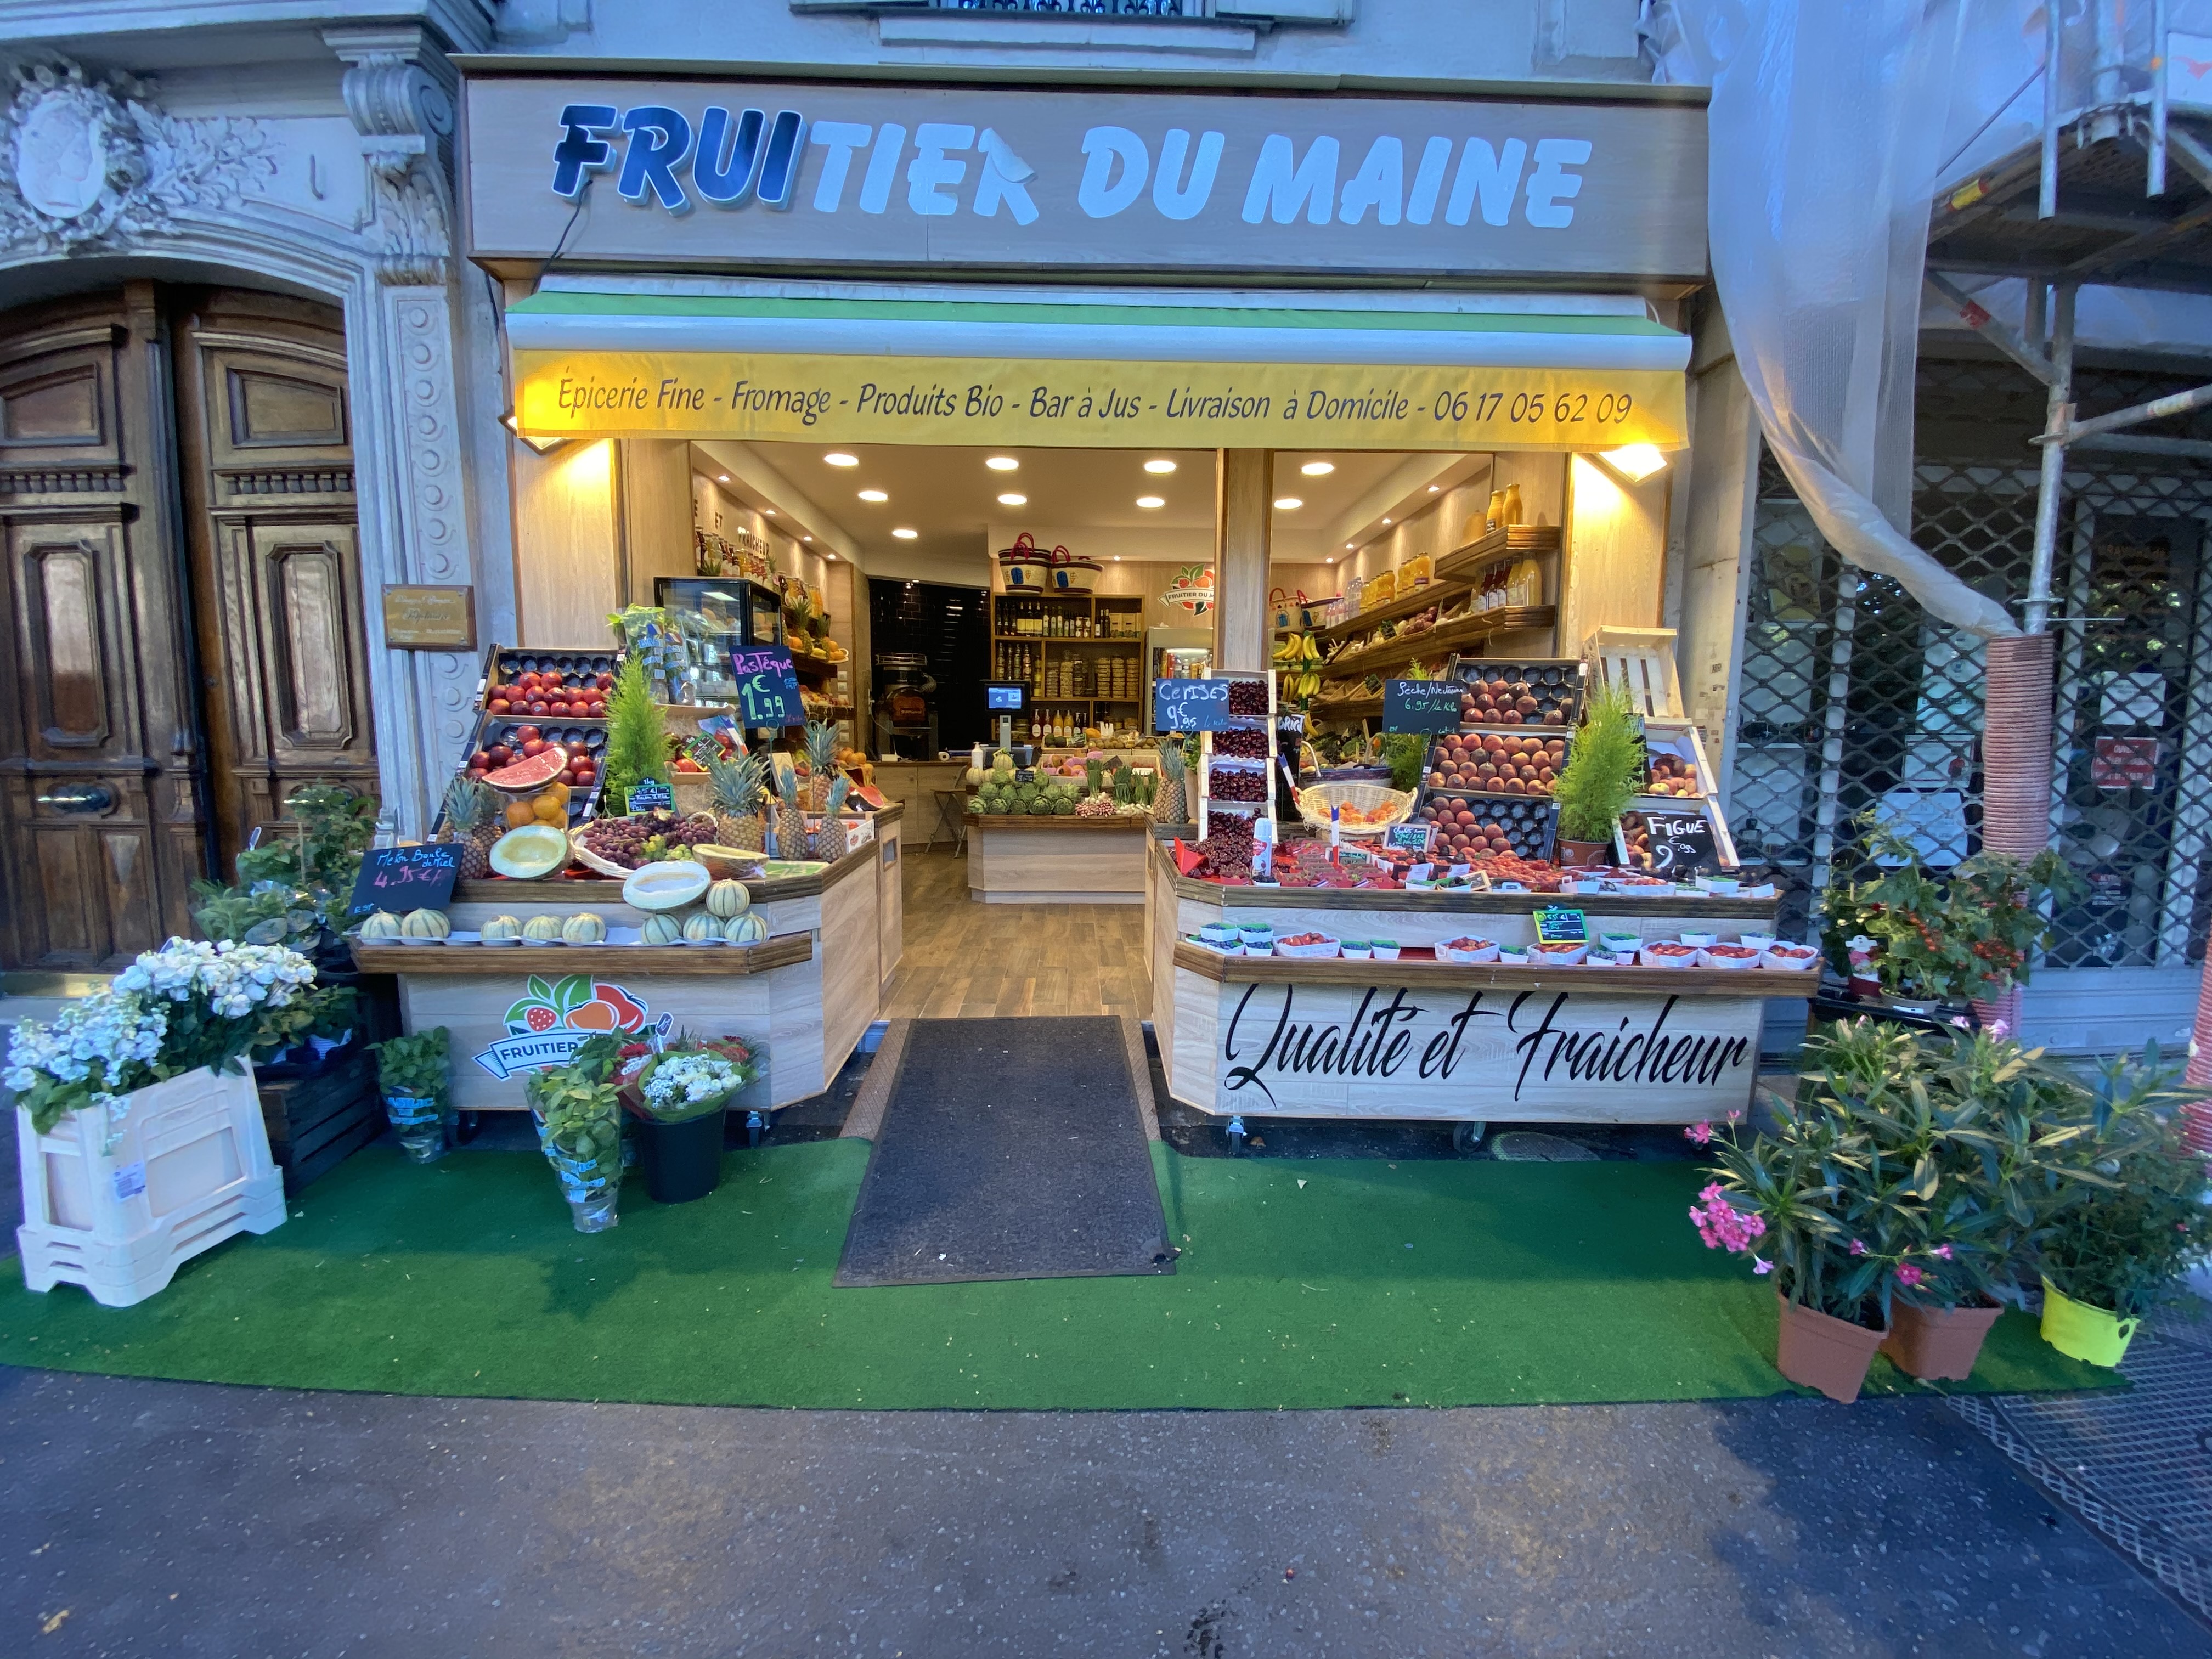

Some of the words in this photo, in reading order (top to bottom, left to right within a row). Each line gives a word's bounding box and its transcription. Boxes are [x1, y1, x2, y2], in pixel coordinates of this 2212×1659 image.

[551, 103, 1039, 226] FRUITIER
[1078, 126, 1225, 219] DU
[1242, 134, 1592, 228] MAINE
[558, 366, 648, 418] Épicerie
[657, 377, 705, 410] Fine
[731, 380, 831, 426] Fromage
[857, 383, 956, 416] Produits
[965, 385, 1003, 417] Bio
[1030, 386, 1074, 418] Bar
[1077, 387, 1093, 418] à
[1098, 388, 1142, 419] Jus
[1166, 387, 1271, 419] Livraison
[1283, 389, 1299, 420] à
[1306, 388, 1409, 420] Domicile
[1434, 391, 1468, 421] 06
[1476, 392, 1503, 421] 17
[1510, 392, 1545, 423] 05
[1554, 393, 1588, 422] 62
[1596, 393, 1633, 424] 09
[1647, 816, 1707, 836] FIGUE
[412, 848, 450, 862] Boule
[500, 1042, 578, 1060] FRUITIER
[1224, 983, 1430, 1110] Qualité
[1419, 991, 1505, 1079] et
[1508, 991, 1749, 1101] Fraicheur
